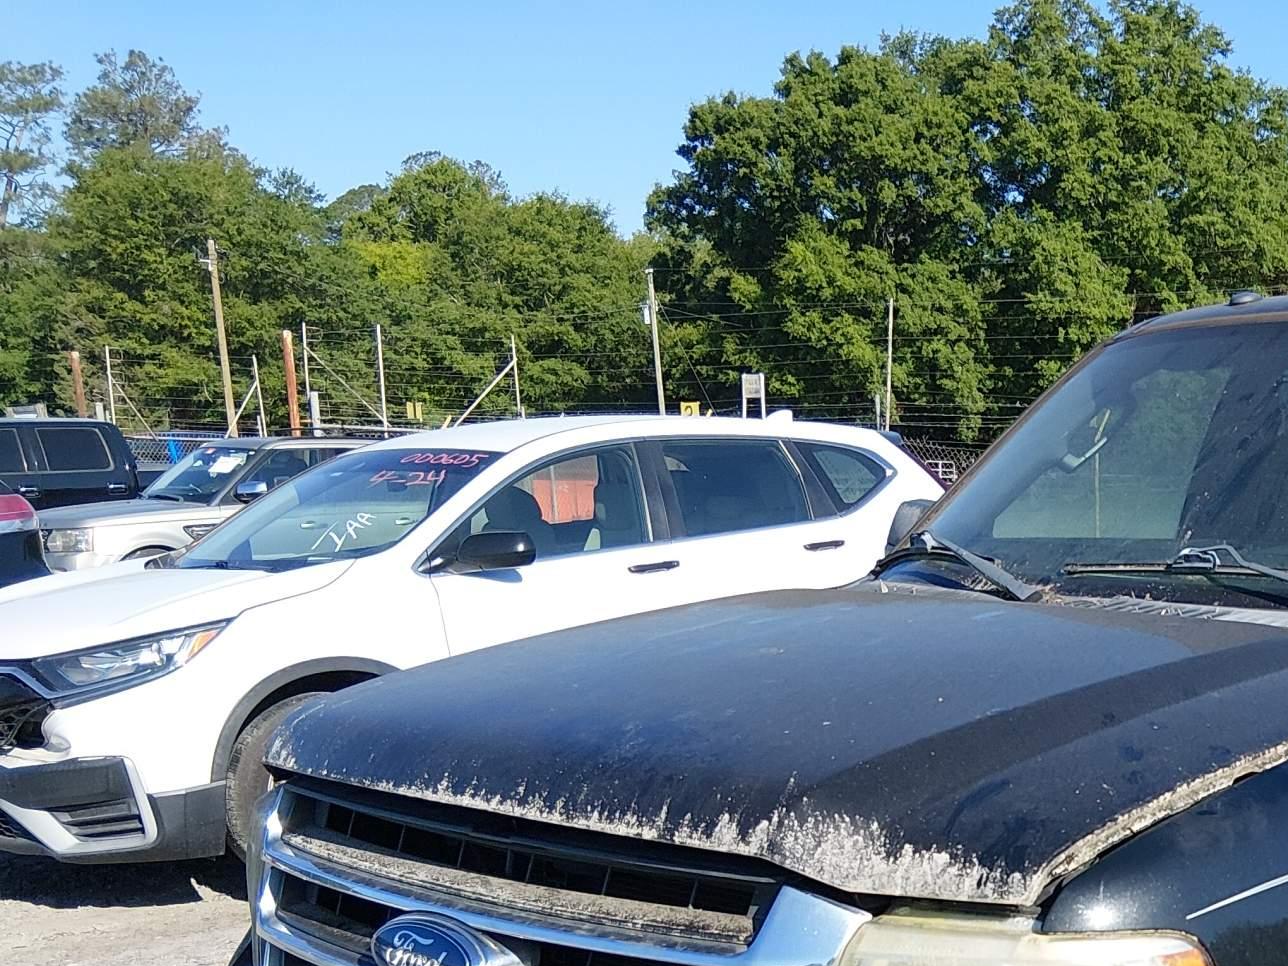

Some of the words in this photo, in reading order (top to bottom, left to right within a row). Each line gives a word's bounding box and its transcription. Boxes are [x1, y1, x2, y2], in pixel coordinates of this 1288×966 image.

[400, 453, 489, 468] 000605
[366, 469, 447, 489] 4-24
[311, 511, 377, 553] IAA
